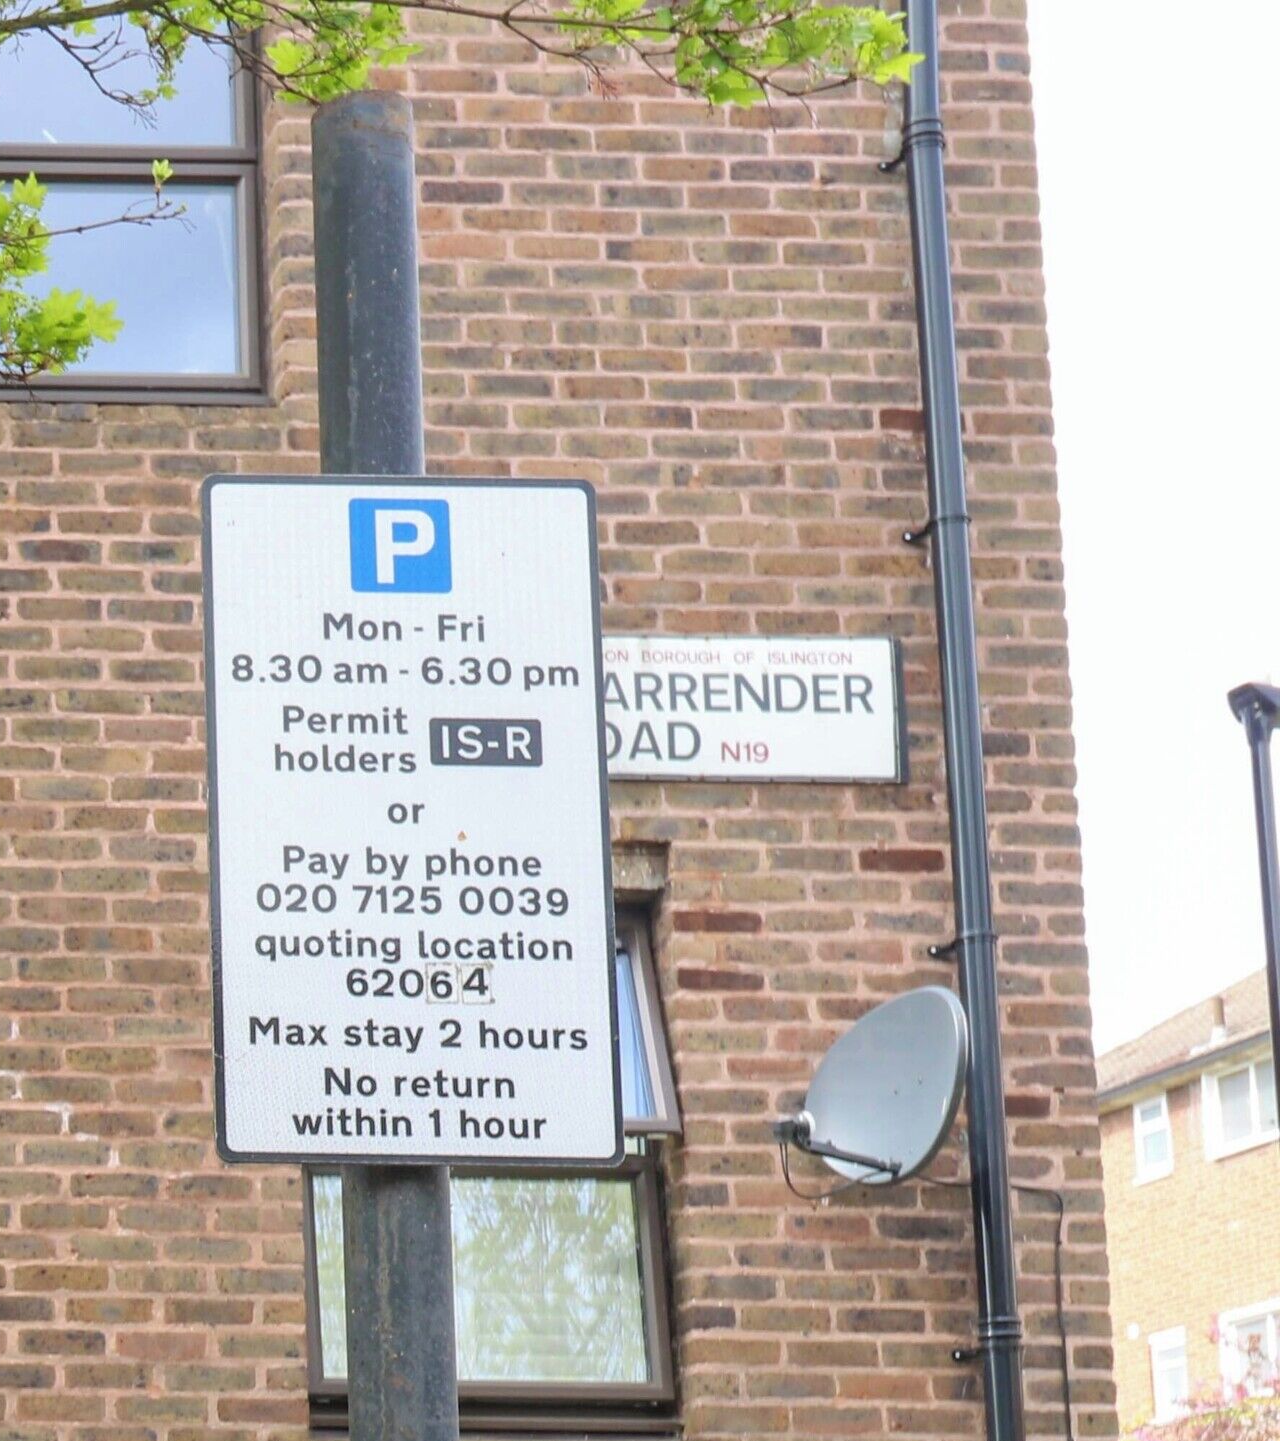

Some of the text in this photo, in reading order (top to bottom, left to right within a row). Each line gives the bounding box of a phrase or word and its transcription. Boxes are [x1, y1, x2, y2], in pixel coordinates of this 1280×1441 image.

[374, 509, 436, 584] P
[323, 613, 402, 641] Mon
[438, 614, 484, 642] Fri
[232, 654, 322, 683] 8.30
[334, 663, 387, 683] am
[421, 657, 512, 685] 6.30
[524, 666, 579, 691] pm
[641, 651, 721, 665] BOROUGH
[734, 652, 755, 665] OF
[767, 652, 853, 666] ISLINGTON
[603, 672, 874, 714] ARRENDER
[283, 705, 408, 735] Permit
[441, 724, 532, 760] IS-R
[721, 741, 770, 764] N19
[274, 744, 417, 773] holders
[388, 803, 425, 824] or
[283, 845, 542, 881] Pay by phone
[257, 883, 569, 916] 020 7125 0039
[255, 929, 573, 964] quoting location
[346, 967, 489, 999] 62064
[249, 1016, 588, 1054] Max stay 2 hours
[324, 1067, 515, 1099] No return
[292, 1107, 547, 1139] within 1 hour
